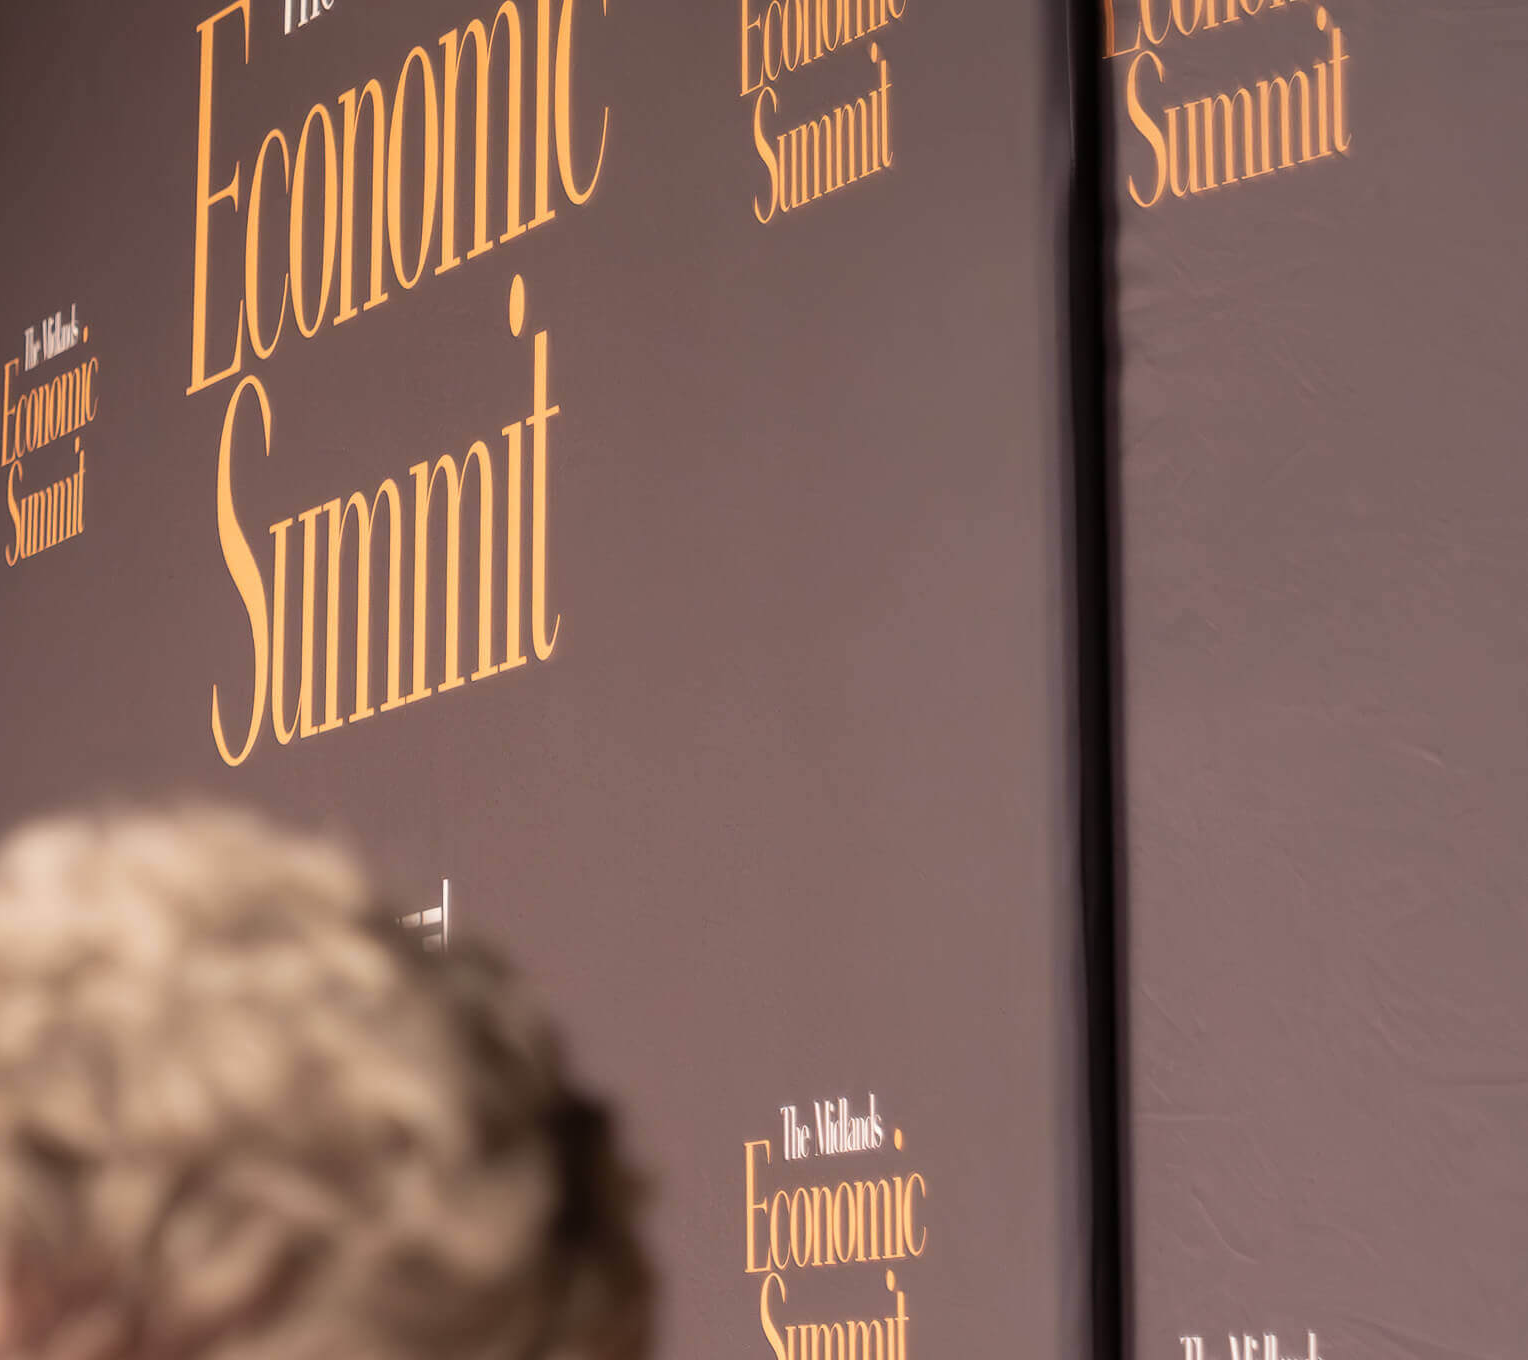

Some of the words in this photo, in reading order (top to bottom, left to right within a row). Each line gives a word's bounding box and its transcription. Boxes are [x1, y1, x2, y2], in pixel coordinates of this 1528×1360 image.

[753, 41, 894, 225] Summit
[1126, 5, 1352, 209] Summit
[186, 0, 610, 397] Economic
[0, 324, 100, 468] Economic
[5, 435, 87, 568] Summit
[211, 273, 561, 768] Summit
[744, 1127, 928, 1273] Economic
[780, 1104, 811, 1161] The
[814, 1090, 884, 1157] Midlands
